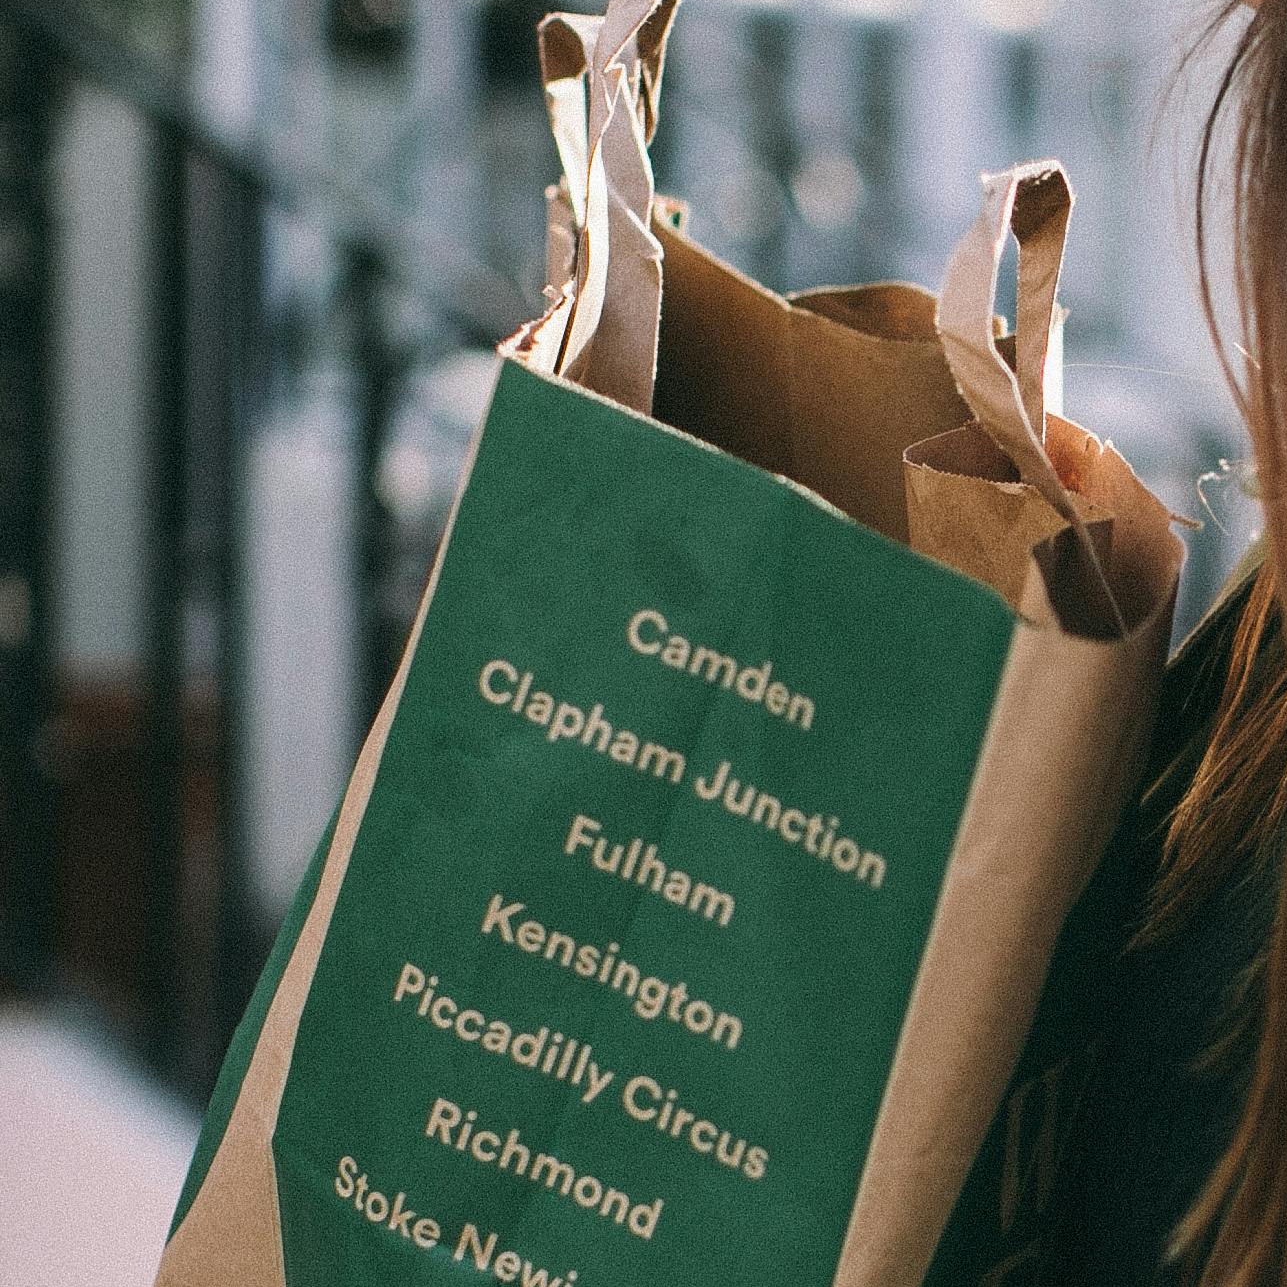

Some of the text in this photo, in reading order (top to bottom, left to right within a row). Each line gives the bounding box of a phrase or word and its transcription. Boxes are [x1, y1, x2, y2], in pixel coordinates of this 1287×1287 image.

[627, 610, 815, 729] Camden
[479, 659, 886, 887] Clapham Junction
[565, 815, 735, 925] Fulham
[482, 895, 743, 1049] Kensington
[394, 963, 769, 1180] Piccadilly Circus
[335, 1155, 442, 1250] Stoke
[425, 1098, 663, 1240] Richmond
